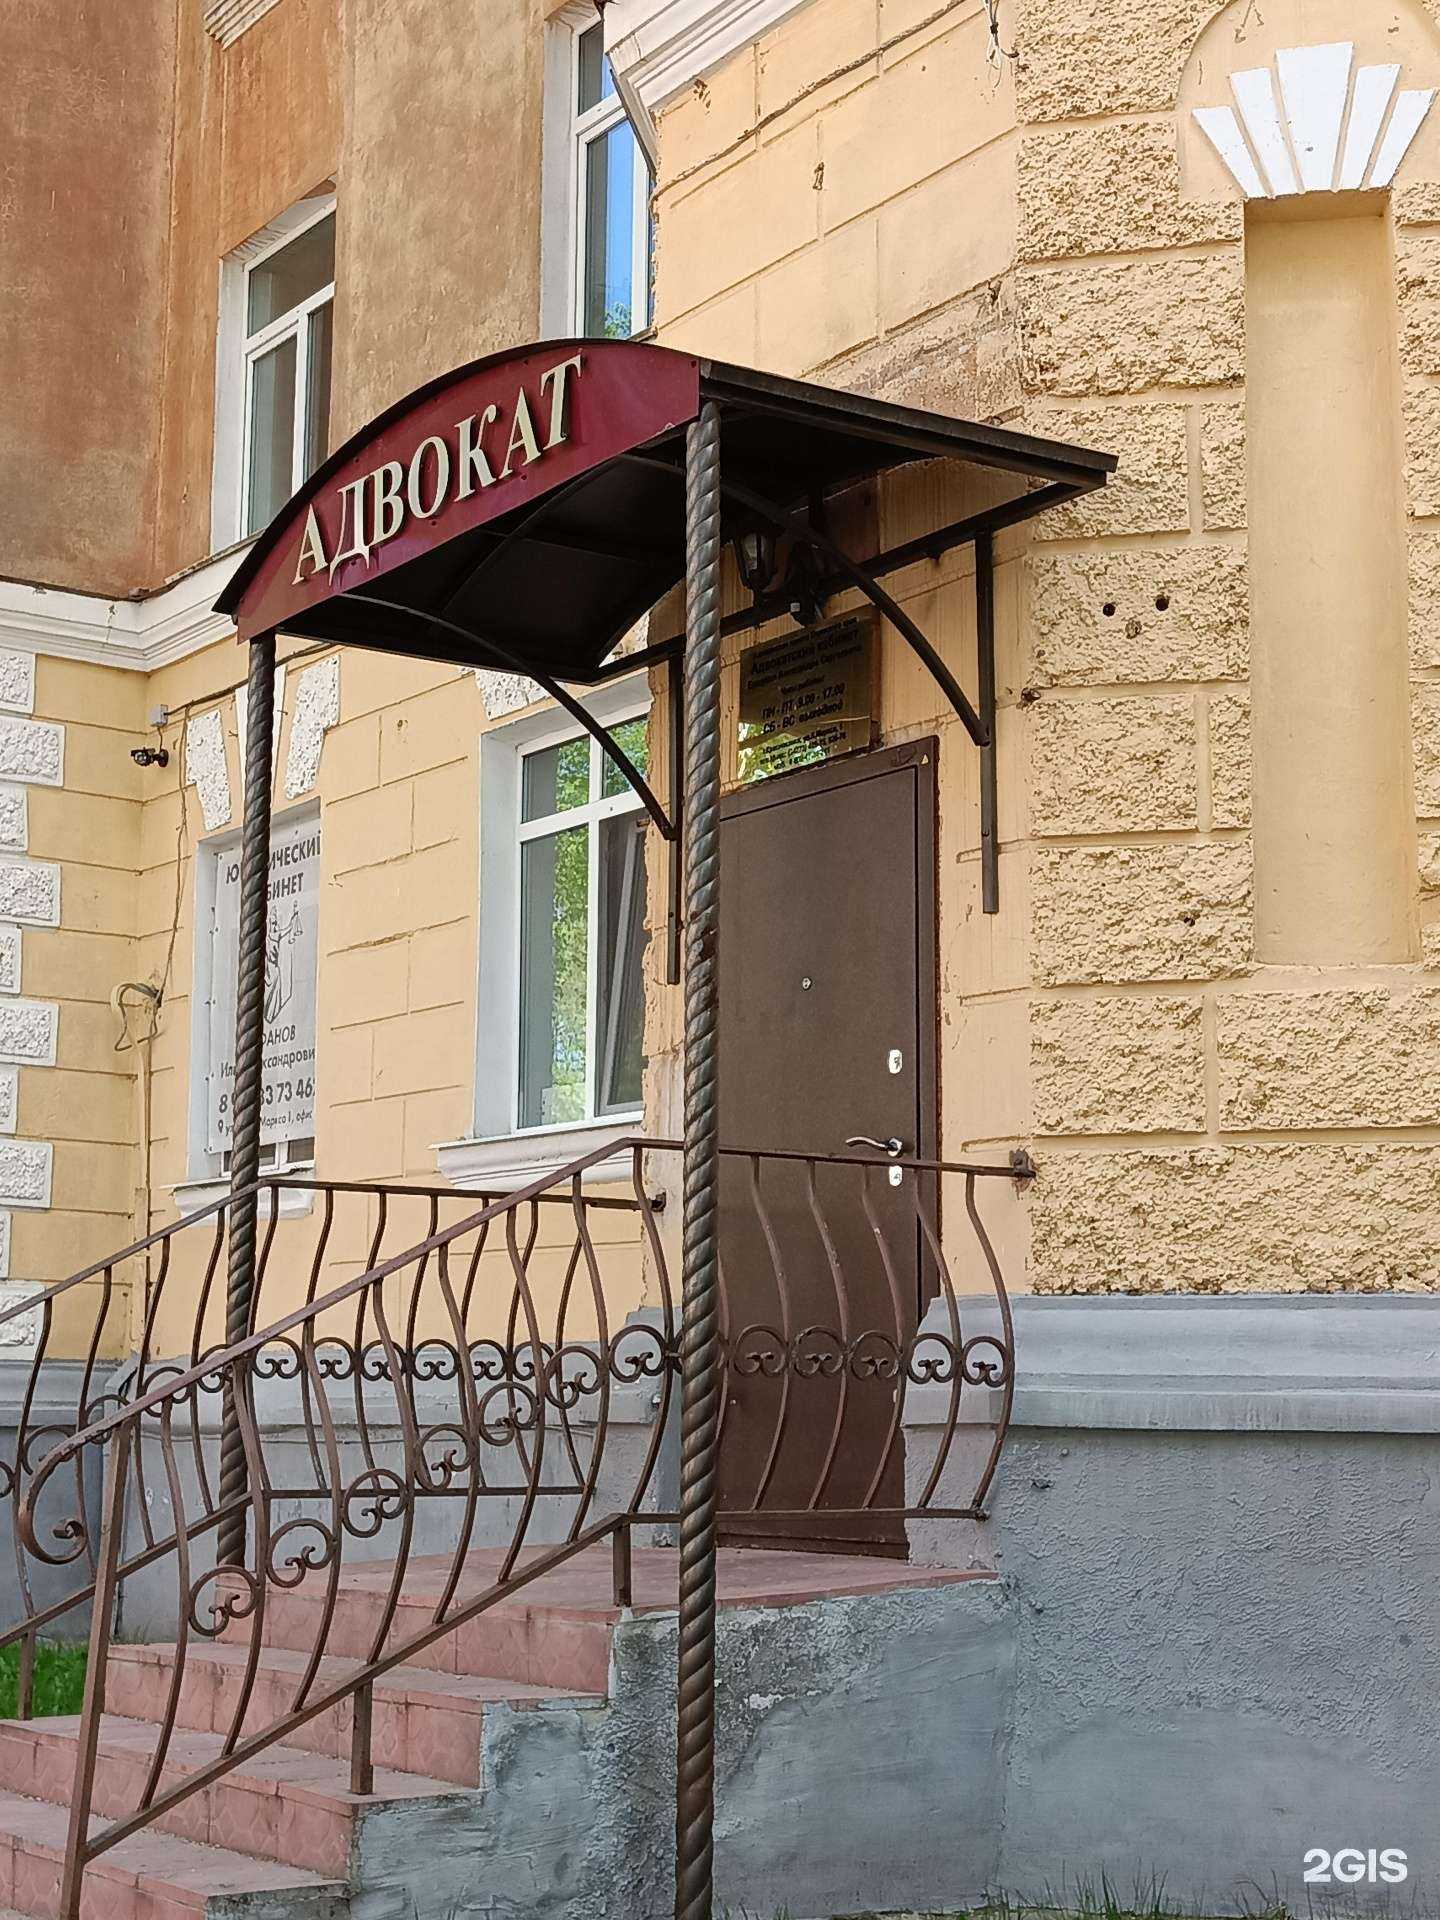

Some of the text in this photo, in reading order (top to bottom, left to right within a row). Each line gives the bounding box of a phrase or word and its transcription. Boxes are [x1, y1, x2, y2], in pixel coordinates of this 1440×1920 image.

[291, 354, 583, 586] АДВОКАТ
[218, 1093, 228, 1114] 8
[276, 1081, 292, 1103] 73
[295, 1077, 315, 1099] 46
